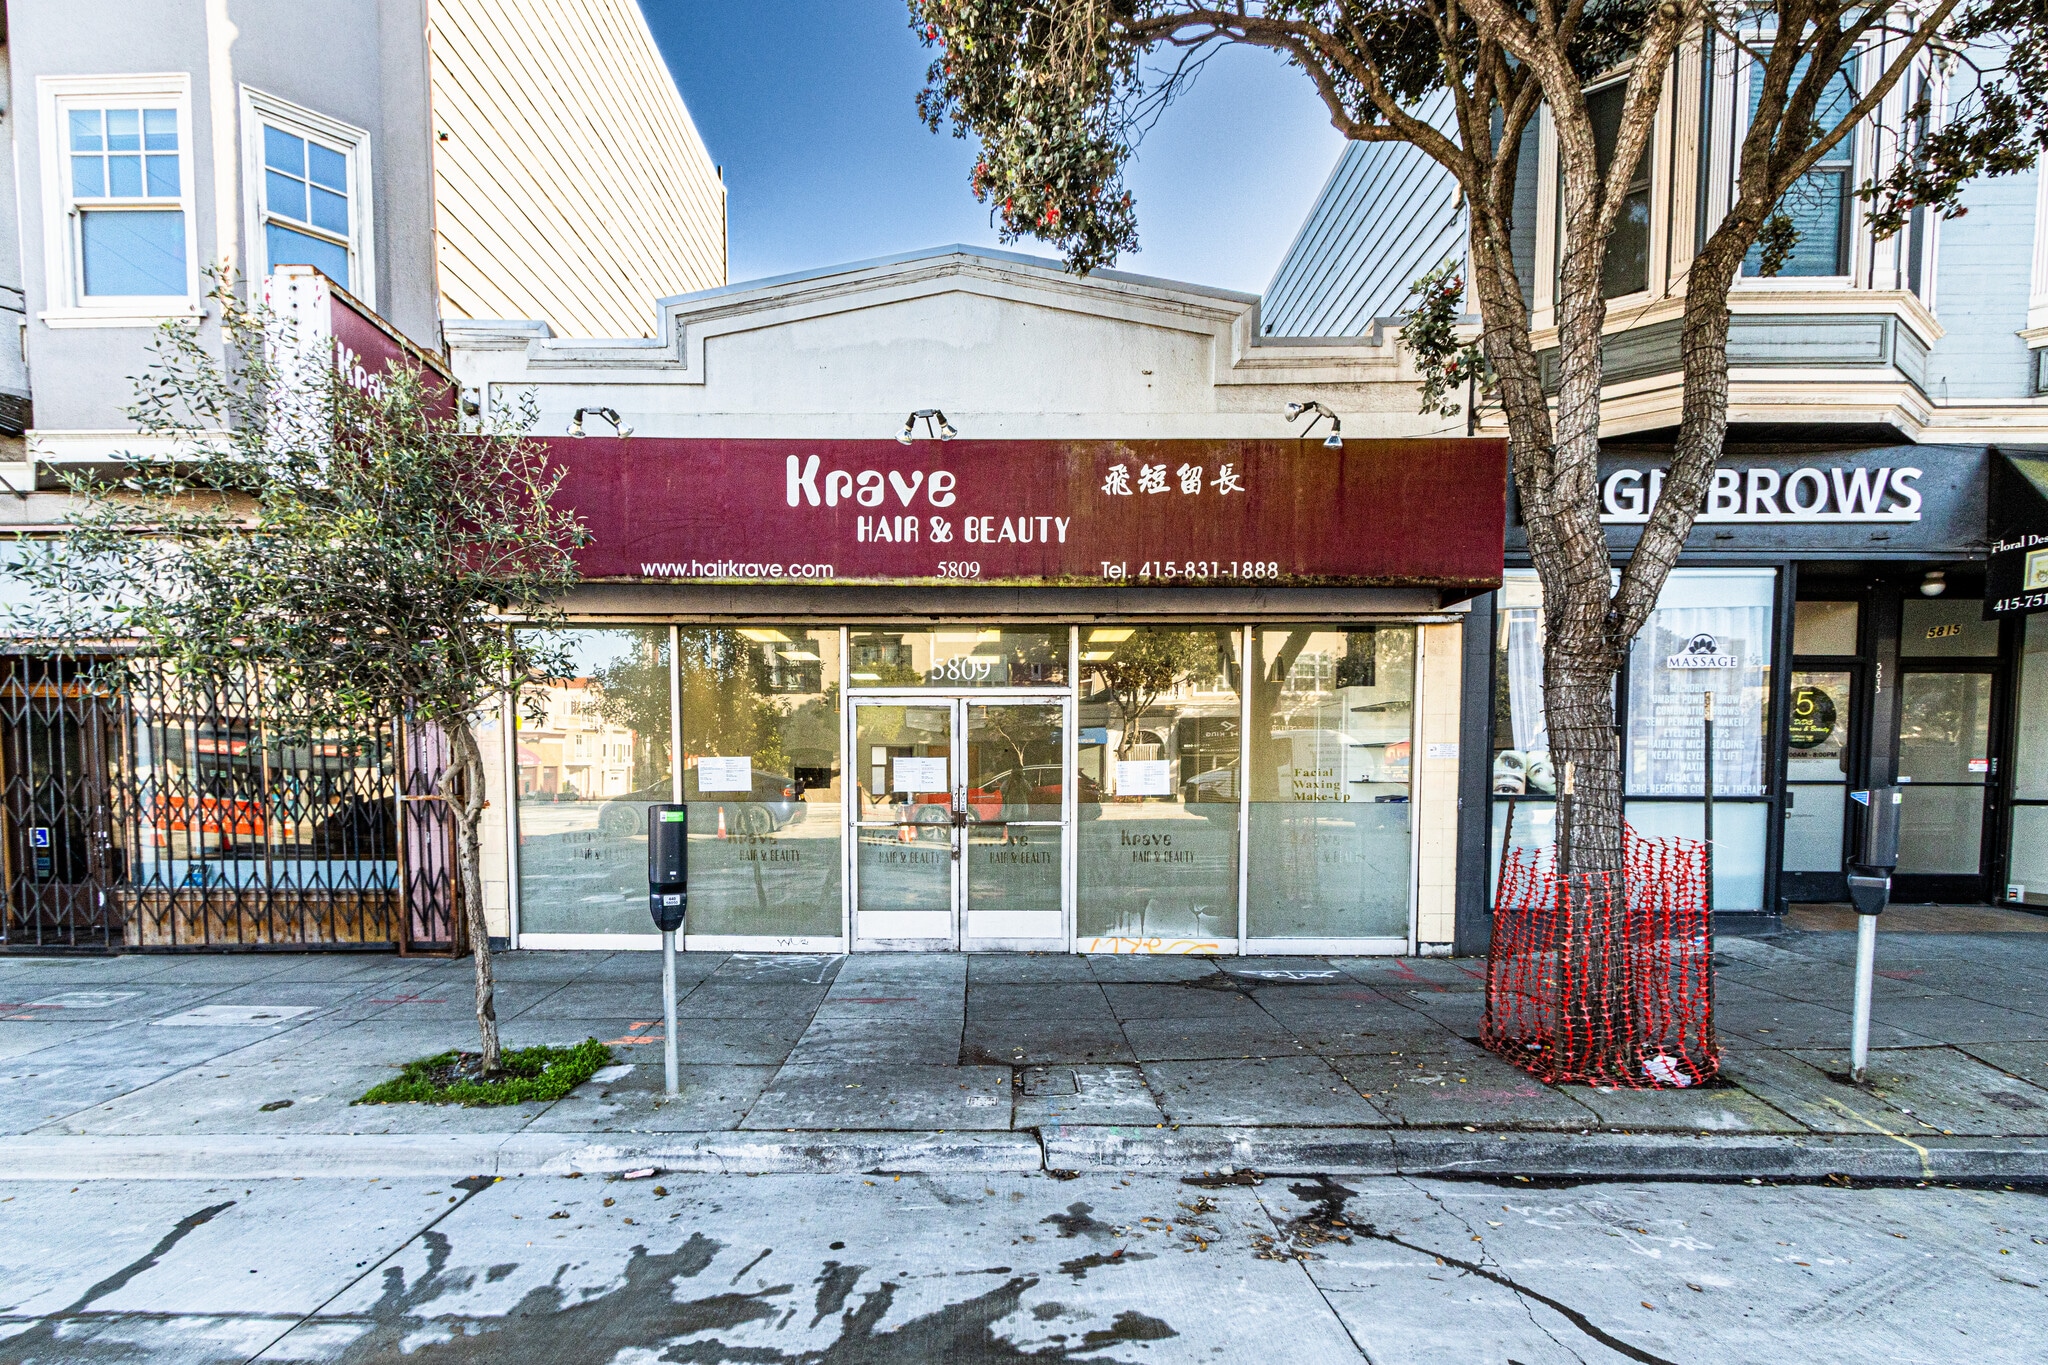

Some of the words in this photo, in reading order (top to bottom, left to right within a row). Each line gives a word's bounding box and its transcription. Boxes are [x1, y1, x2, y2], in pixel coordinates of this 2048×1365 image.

[337, 341, 394, 402] Kra
[786, 454, 956, 508] Krave
[1101, 463, 1245, 496] 飛短留長
[1707, 467, 1923, 514] BROWS
[857, 515, 919, 543] HAIR
[929, 515, 953, 543] &
[964, 516, 1070, 543] BEAUTY
[1992, 536, 2025, 554] Floral
[640, 559, 834, 578] www.hairkrave.com
[937, 561, 981, 578] 5809
[1101, 562, 1132, 579] Tel.
[1139, 562, 1279, 579] 415-831-1888
[1928, 624, 1961, 637] 5815
[932, 658, 990, 680] 5809
[1668, 656, 1737, 667] MASSAGE
[1656, 706, 1709, 716] COMBINATIO
[1796, 692, 1814, 715] 5
[1668, 717, 1712, 727] PERMANE
[1295, 768, 1333, 777] Facial
[1680, 762, 1709, 771] WAXIN
[1294, 780, 1341, 791] Waxing
[1694, 773, 1724, 782] WANG
[1294, 792, 1351, 803] Make-Up
[1121, 829, 1172, 846] Krave
